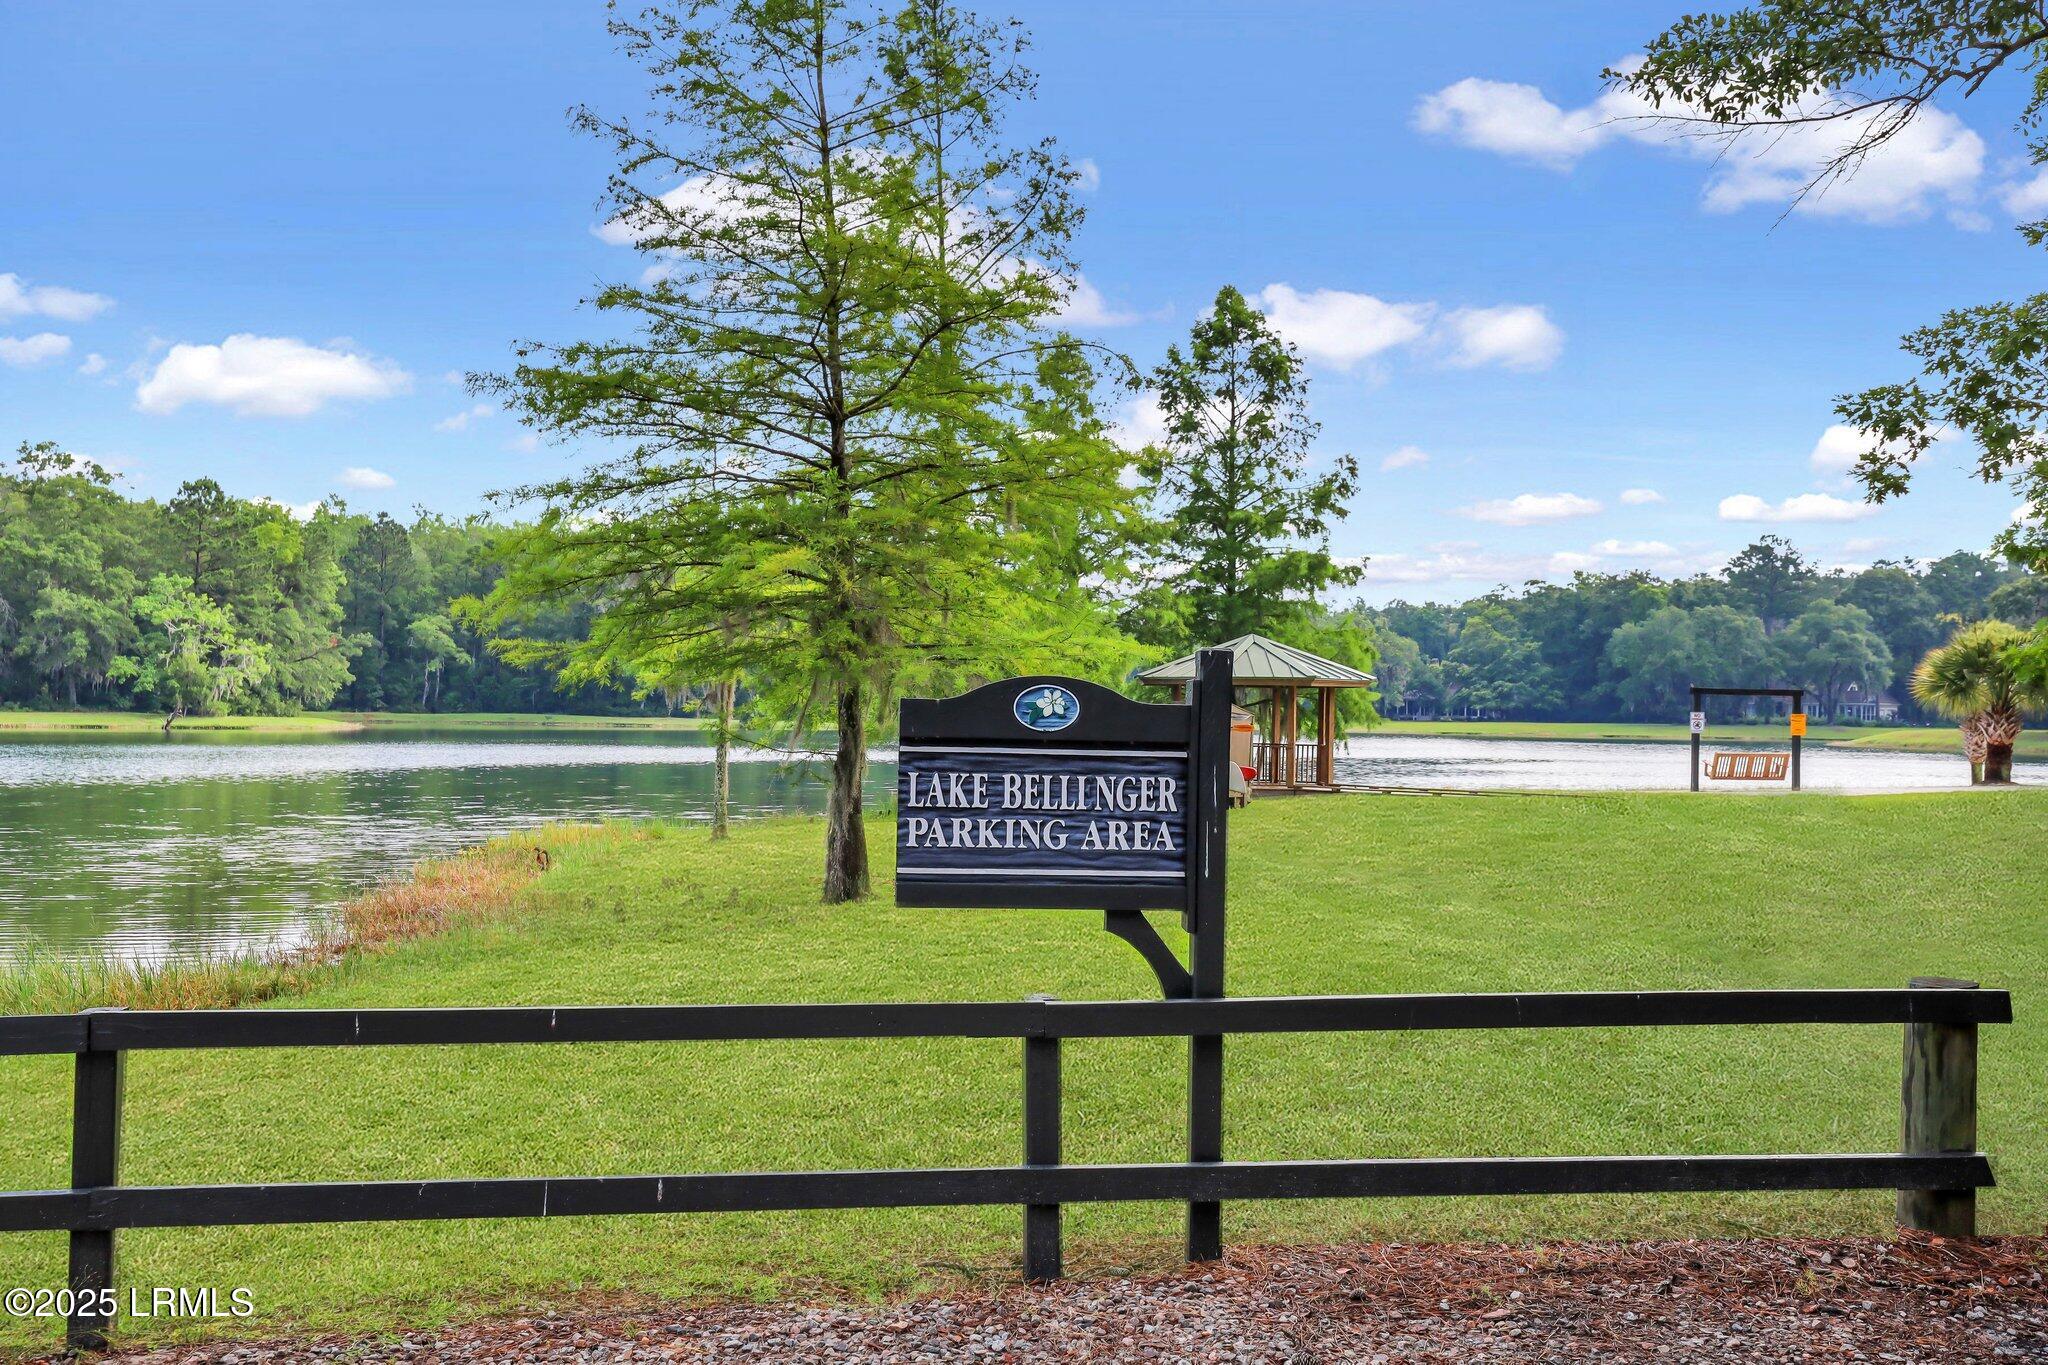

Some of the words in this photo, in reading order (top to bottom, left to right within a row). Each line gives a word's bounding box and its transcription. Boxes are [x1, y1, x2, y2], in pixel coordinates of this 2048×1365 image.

[907, 772, 989, 809] LAKE
[1001, 773, 1178, 812] BELLINGER
[906, 817, 1069, 850] PARKING
[1081, 820, 1176, 851] AREA
